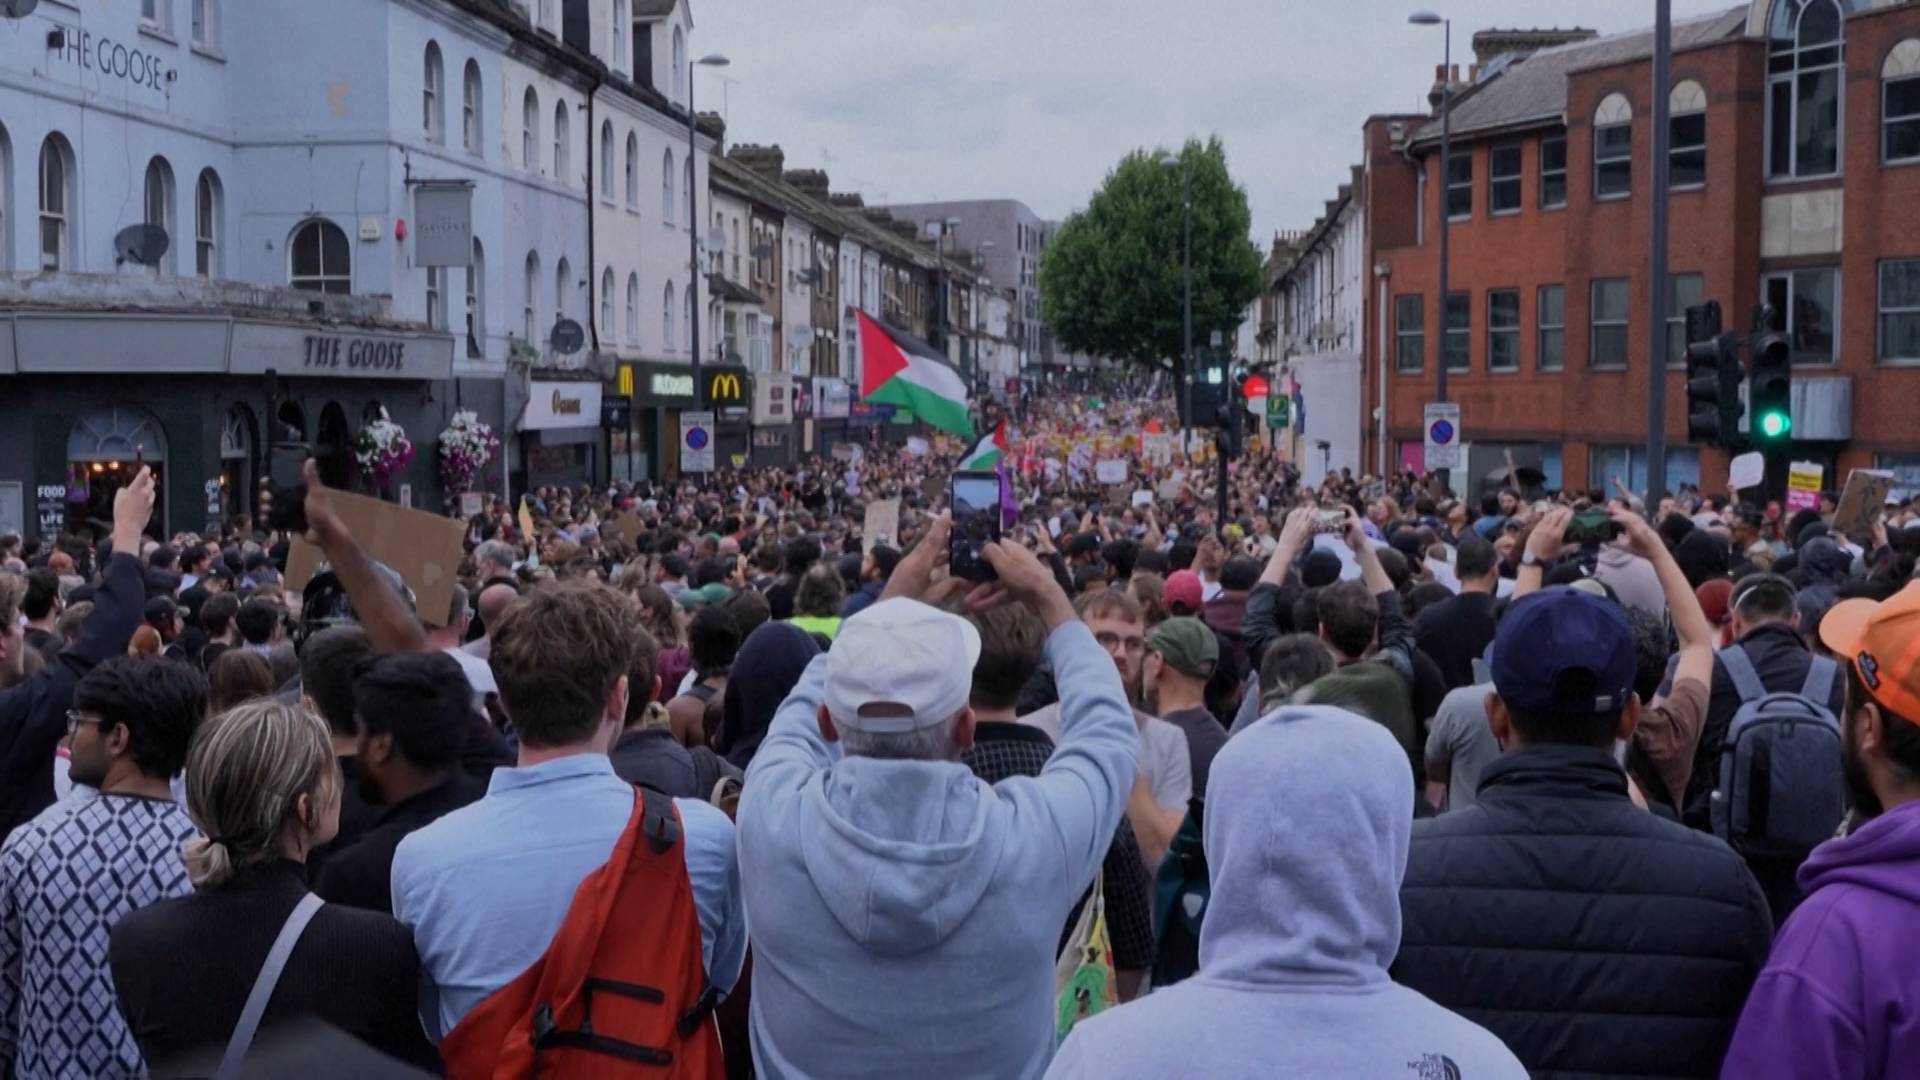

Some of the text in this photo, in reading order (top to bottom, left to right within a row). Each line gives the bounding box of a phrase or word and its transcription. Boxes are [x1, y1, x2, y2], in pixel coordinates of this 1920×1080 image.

[97, 37, 161, 91] GOOSE
[303, 336, 405, 370] THE GOOSE
[37, 485, 66, 498] FOOD
[40, 514, 64, 524] LIFE
[1406, 1061, 1442, 1071] NORTH
